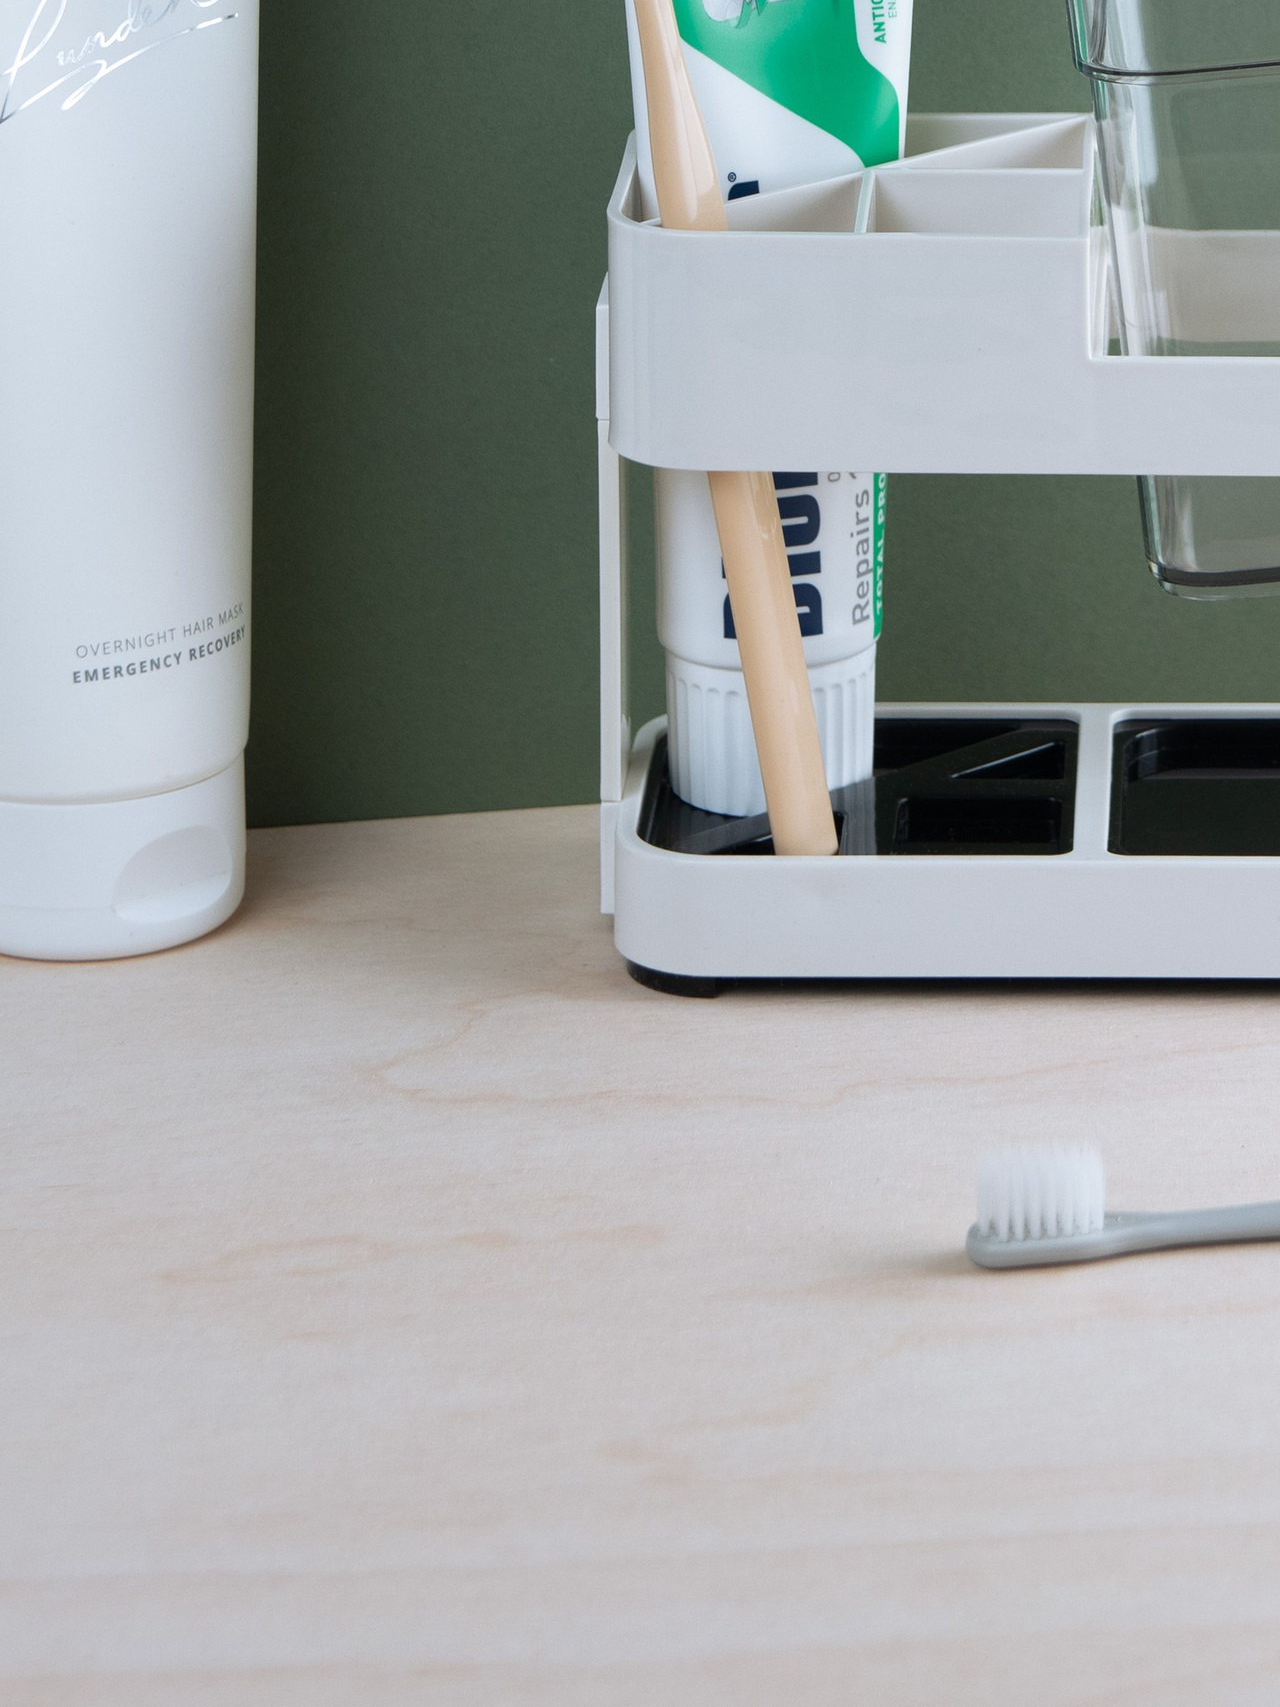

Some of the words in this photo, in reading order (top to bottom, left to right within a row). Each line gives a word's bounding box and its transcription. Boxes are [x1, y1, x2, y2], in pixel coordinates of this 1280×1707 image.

[850, 489, 873, 625] Repairs
[876, 529, 884, 615] TOTAL
[73, 651, 182, 684] EMERGENCY
[189, 625, 246, 661] RECOVERY
[76, 627, 176, 659] OVERNIGHT
[183, 616, 214, 638] HAIR
[218, 601, 244, 626] MASK
